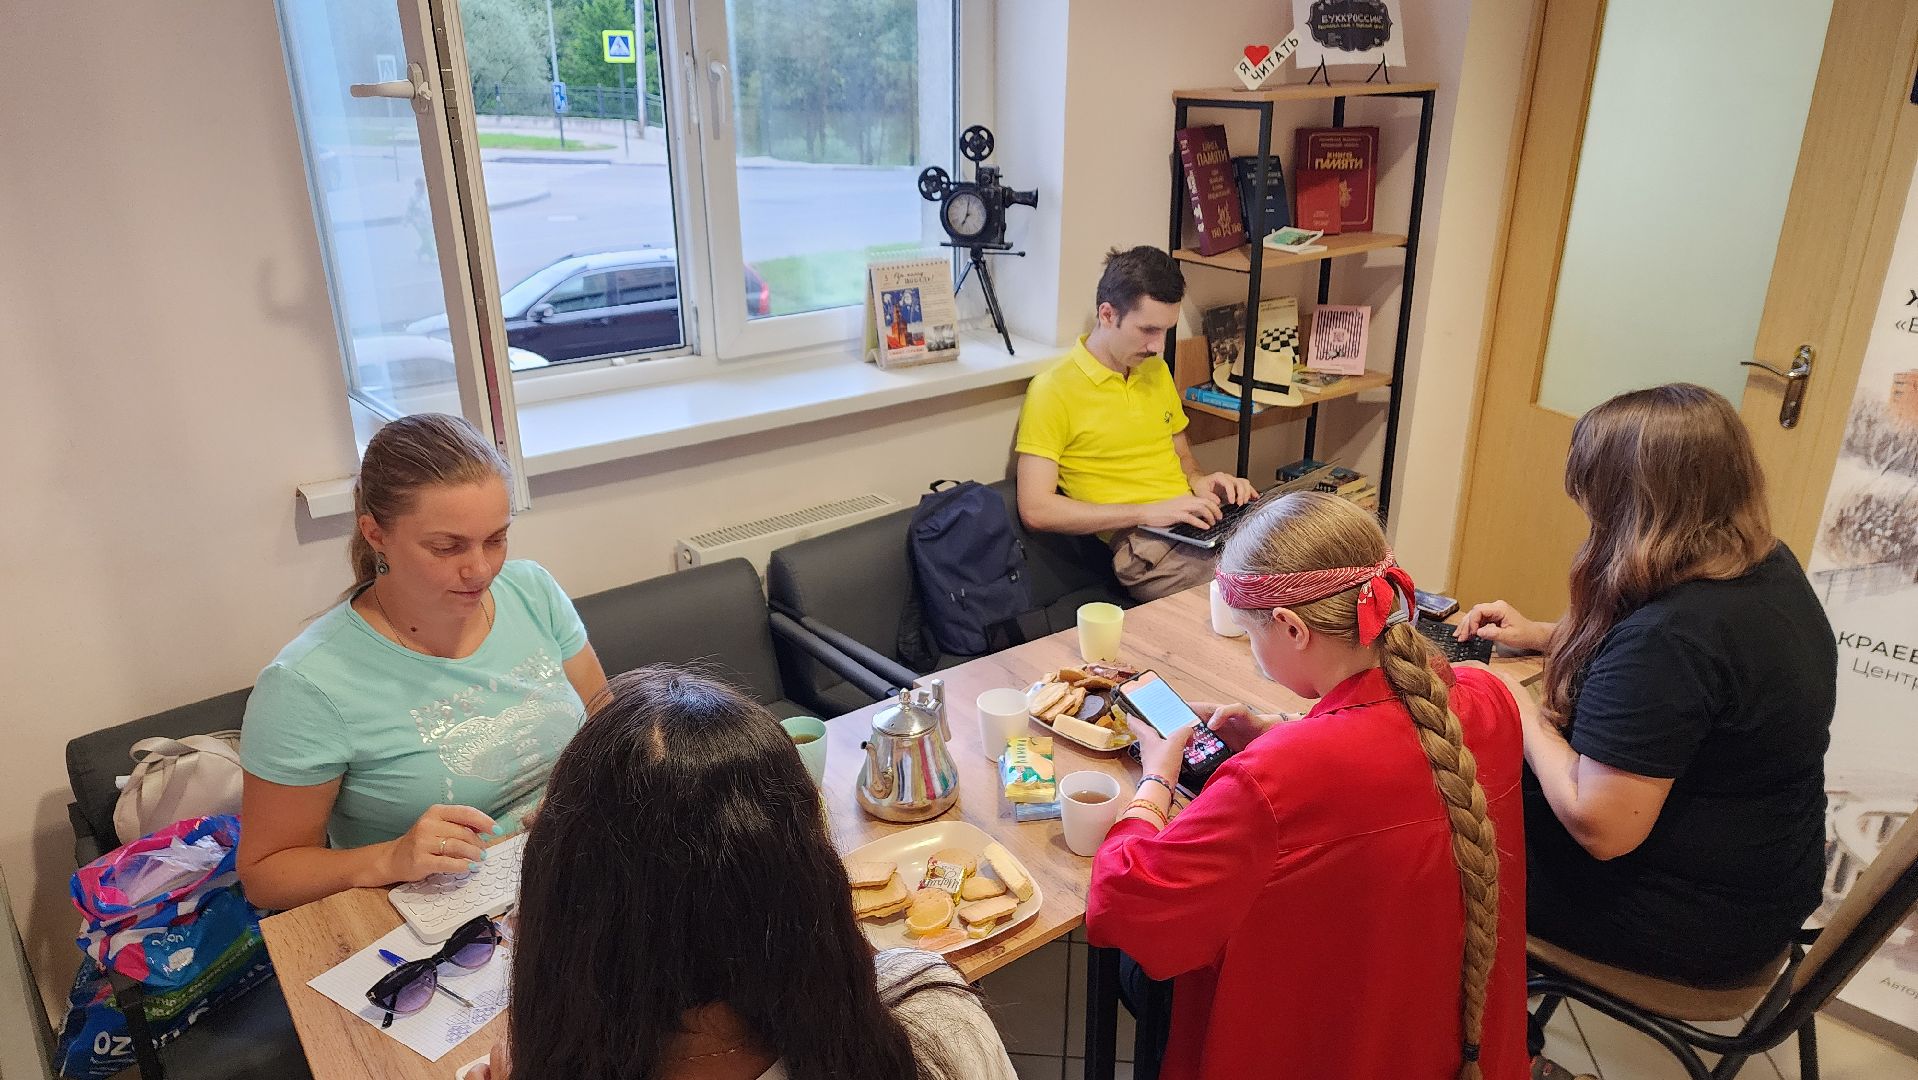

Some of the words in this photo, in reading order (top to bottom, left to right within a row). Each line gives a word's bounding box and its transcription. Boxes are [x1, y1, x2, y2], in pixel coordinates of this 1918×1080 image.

[1250, 38, 1299, 81] ЧИТАТЬ
[1239, 61, 1251, 75] Я
[1314, 158, 1364, 170] ПАМЯТИ
